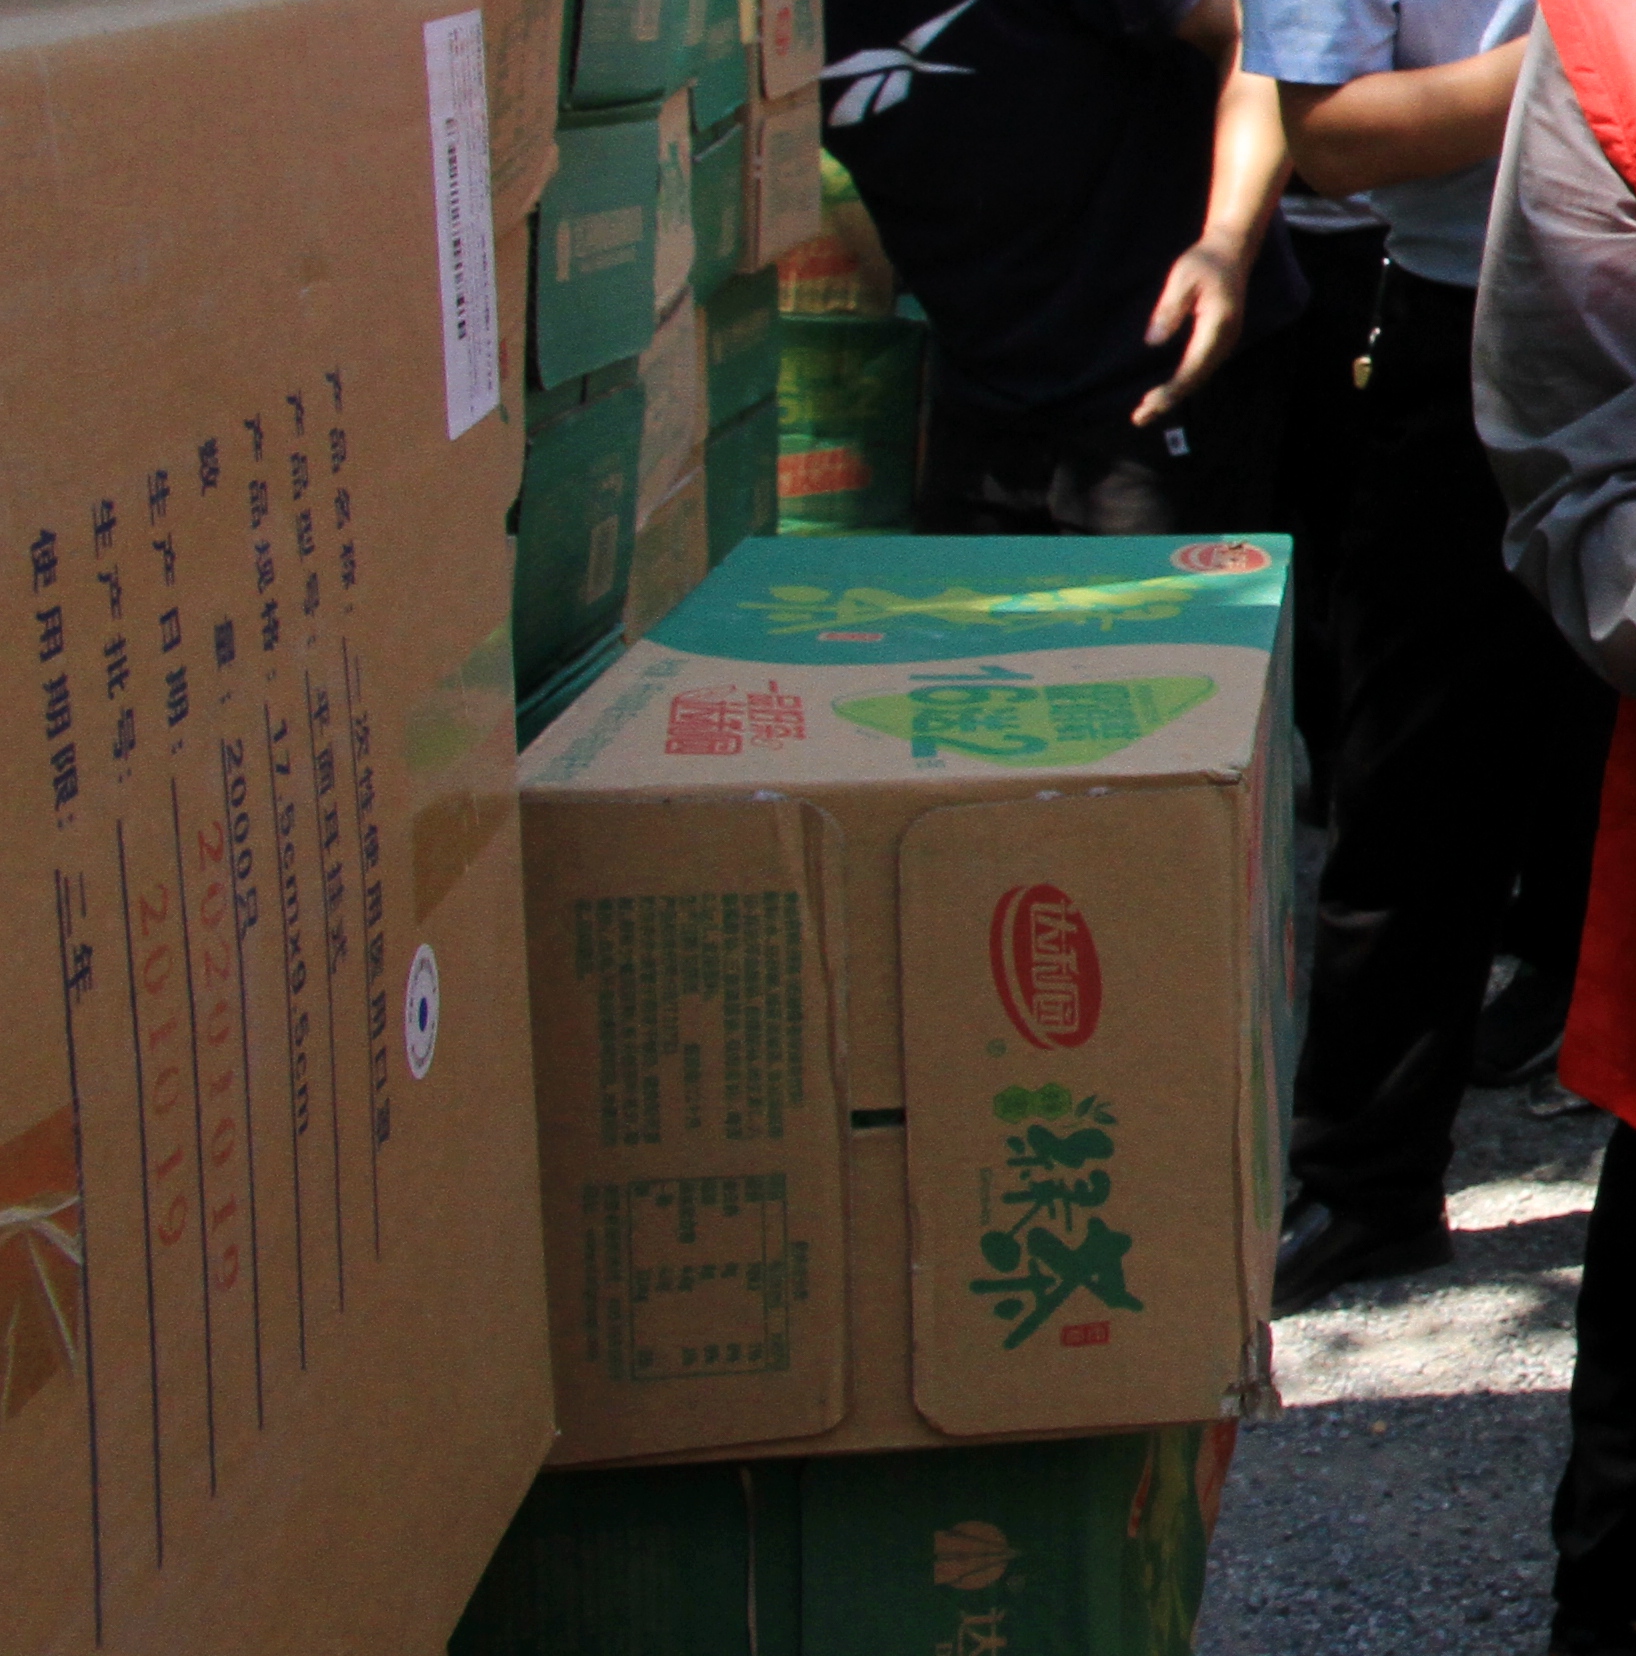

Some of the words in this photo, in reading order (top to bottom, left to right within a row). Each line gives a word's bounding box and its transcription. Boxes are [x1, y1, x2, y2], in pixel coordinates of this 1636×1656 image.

[30, 528, 79, 829] 使用期限：
[64, 870, 94, 1004] 二年
[243, 414, 279, 681] 产品规格：
[285, 388, 320, 647] 产品型号：
[312, 686, 348, 974] 平面耳挂式
[325, 366, 355, 619] 产品名称：
[350, 652, 390, 1143] 一次性使用医用口罩
[93, 500, 135, 784] 生产批号：
[135, 885, 189, 1246] 201019
[148, 468, 188, 756] 生产日期：
[198, 819, 241, 1292] 20201019
[226, 739, 258, 938] 2000只
[1031, 899, 1081, 1035] 达利园
[968, 1125, 1144, 1349] 绿茶
